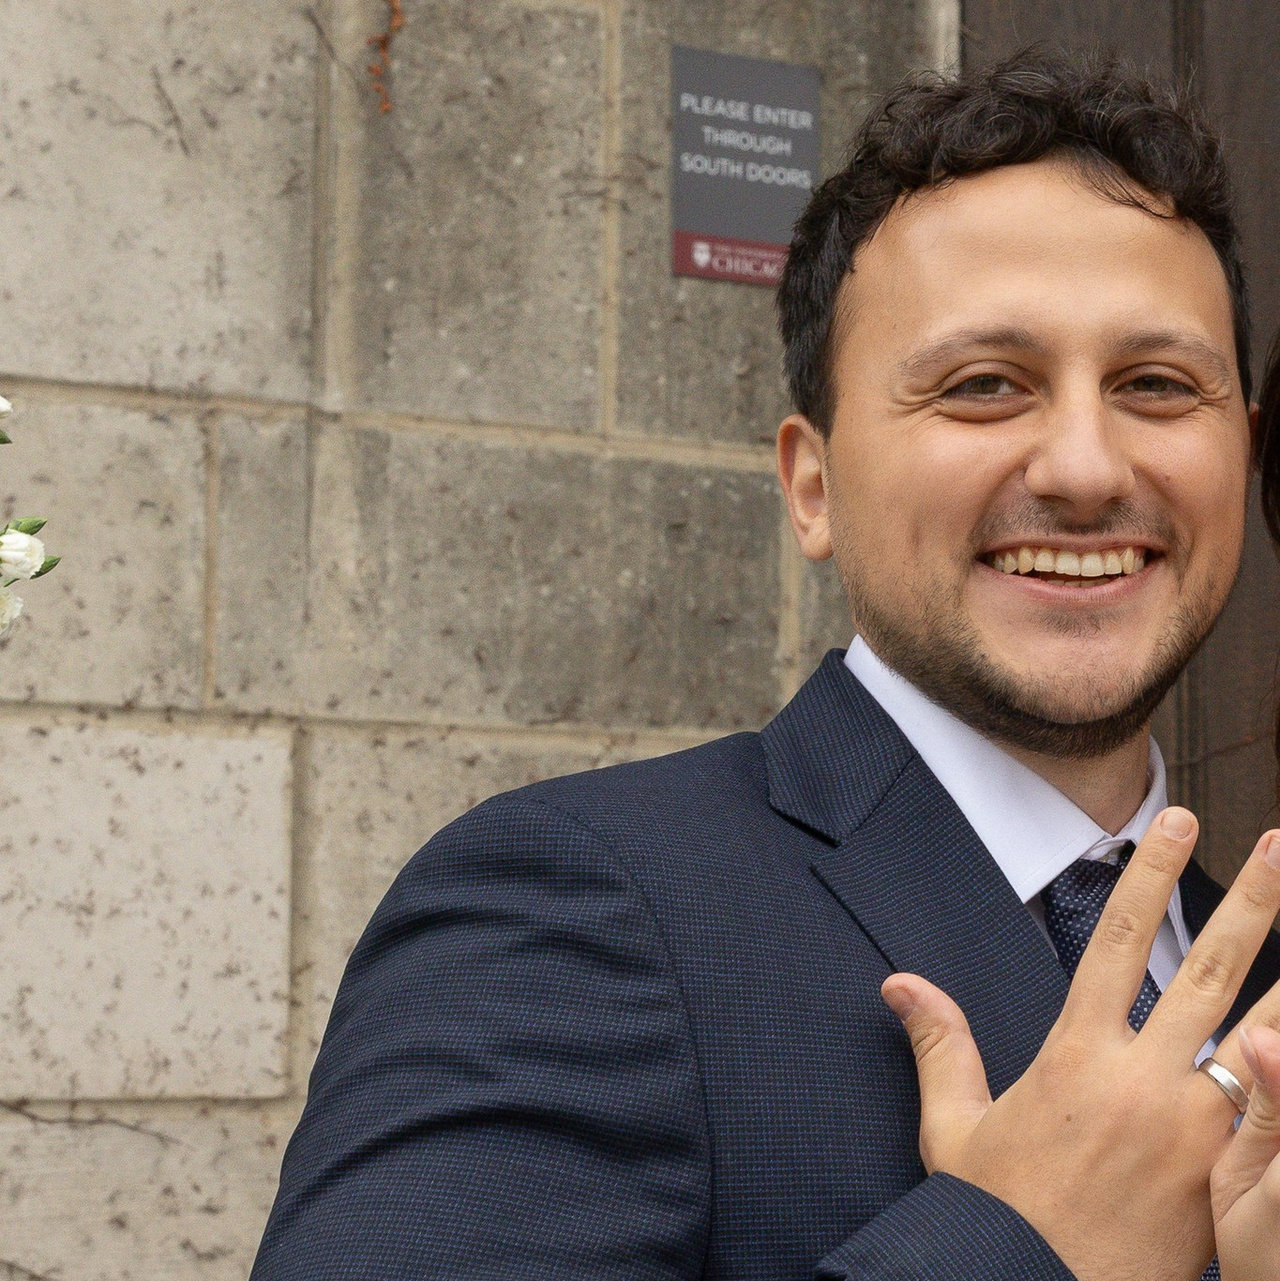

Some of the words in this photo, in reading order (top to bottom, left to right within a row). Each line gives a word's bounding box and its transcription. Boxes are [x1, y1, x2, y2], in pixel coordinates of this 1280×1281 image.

[680, 92, 749, 121] PLEASE
[753, 104, 814, 130] ENTER
[702, 125, 794, 157] THROUGH
[680, 153, 744, 179] SOUTH
[746, 162, 812, 189] DOORS
